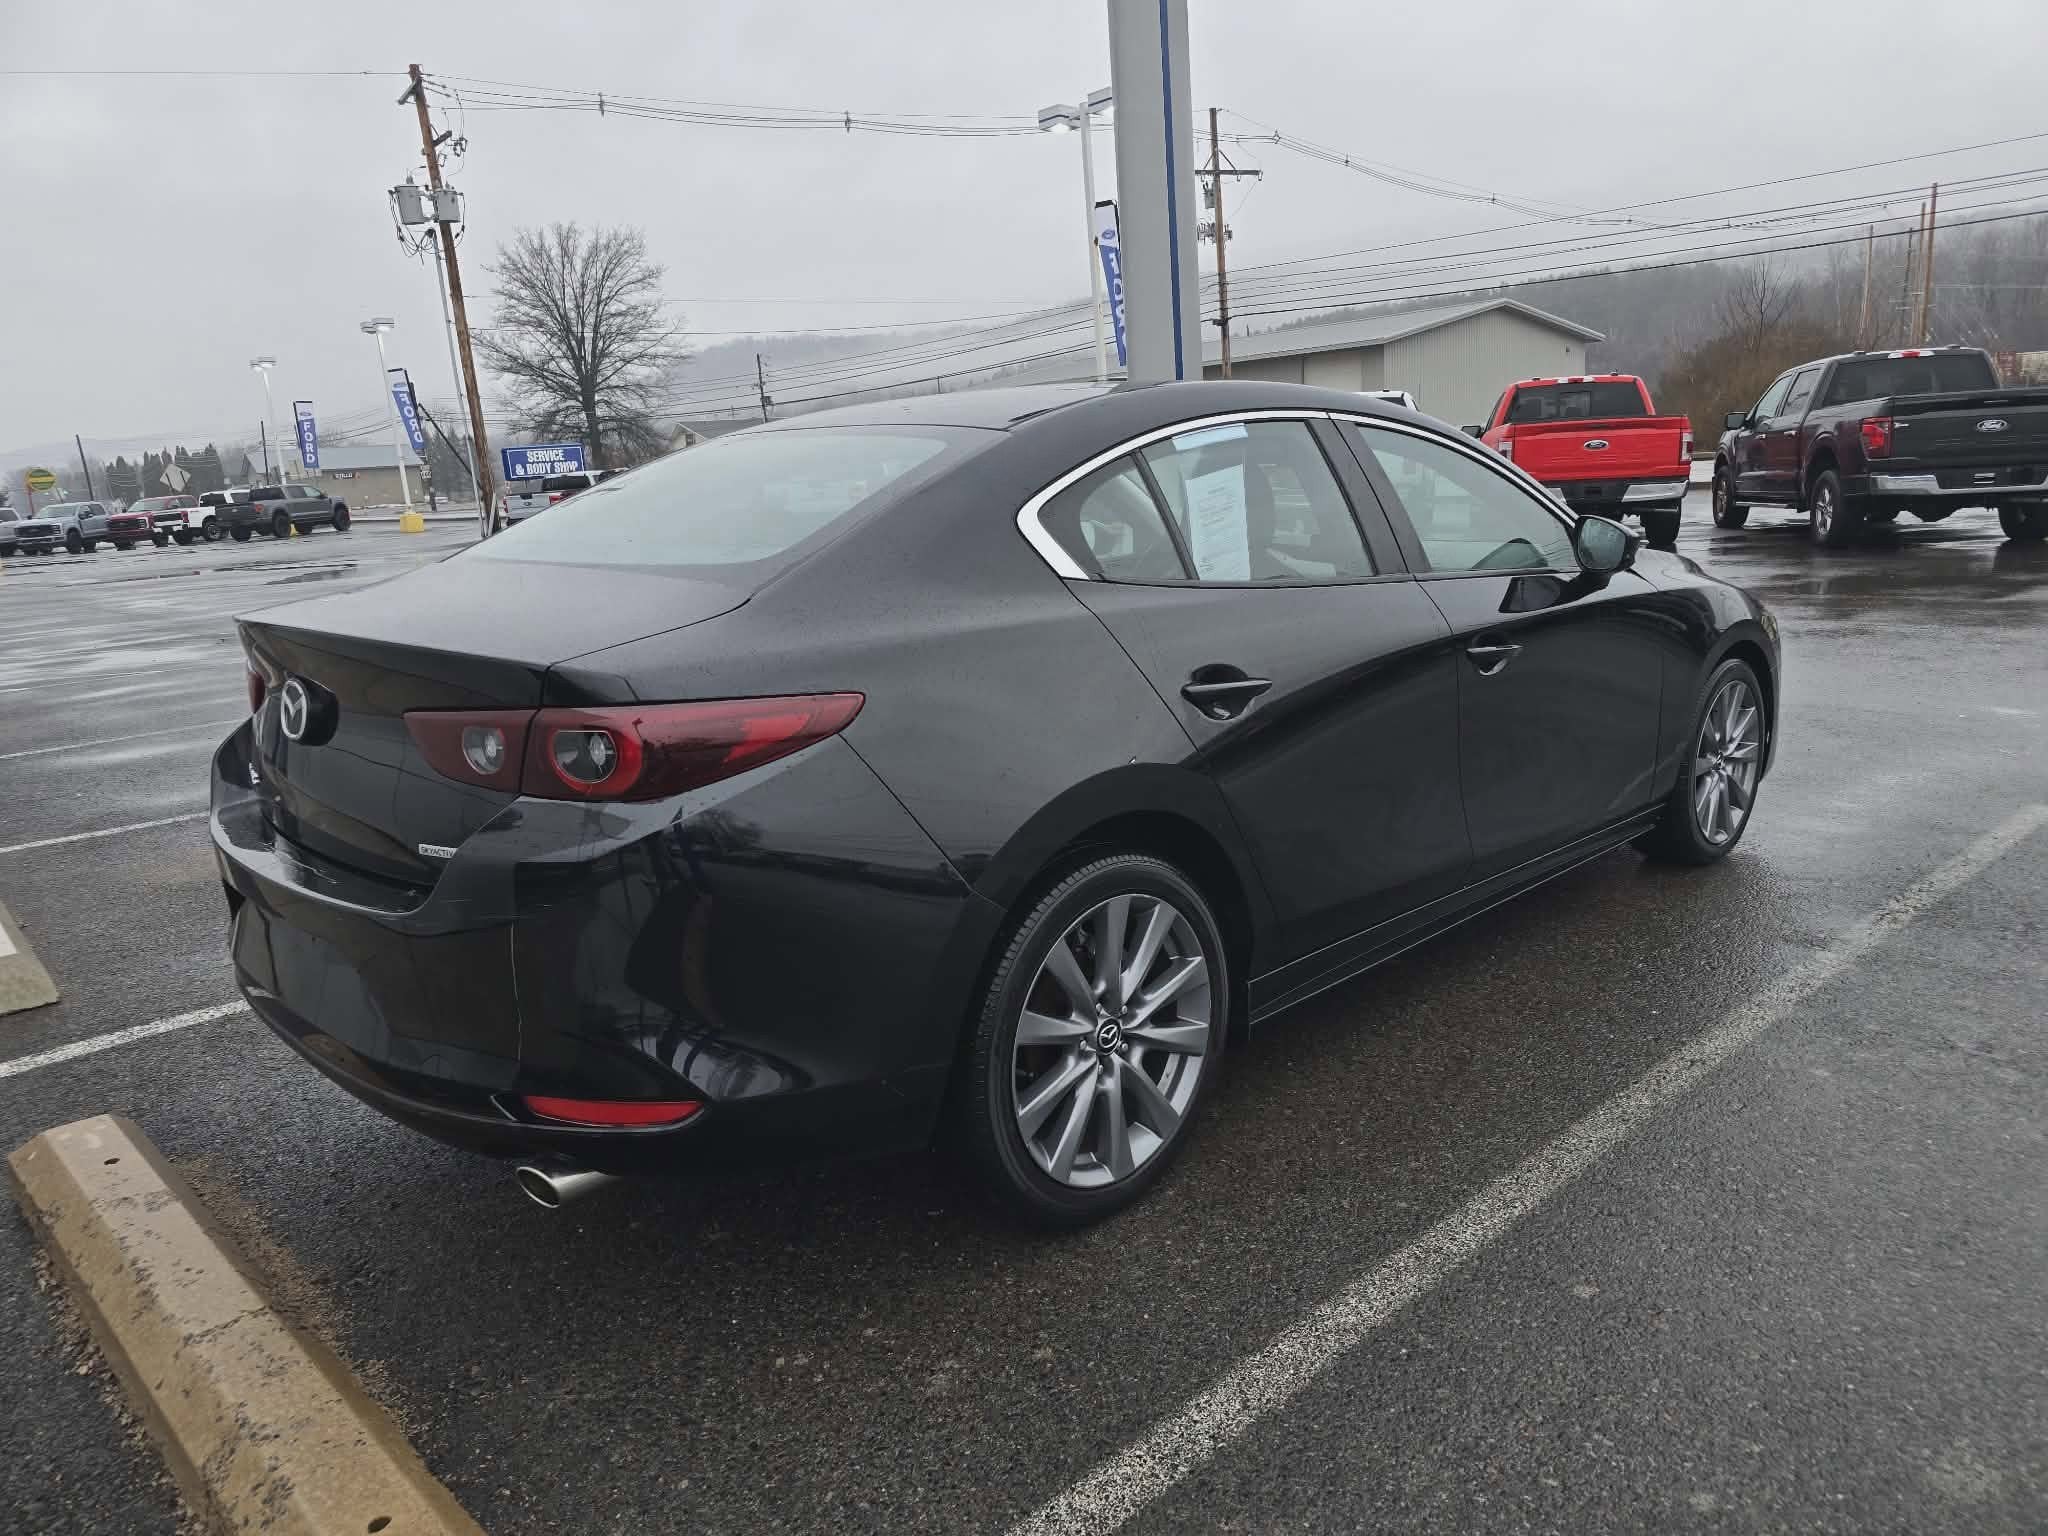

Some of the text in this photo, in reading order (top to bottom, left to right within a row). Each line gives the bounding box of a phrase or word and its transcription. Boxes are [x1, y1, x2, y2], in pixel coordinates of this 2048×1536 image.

[303, 421, 315, 463] FORD
[527, 449, 565, 462] SERVICE
[515, 460, 578, 475] & BODY SHOP
